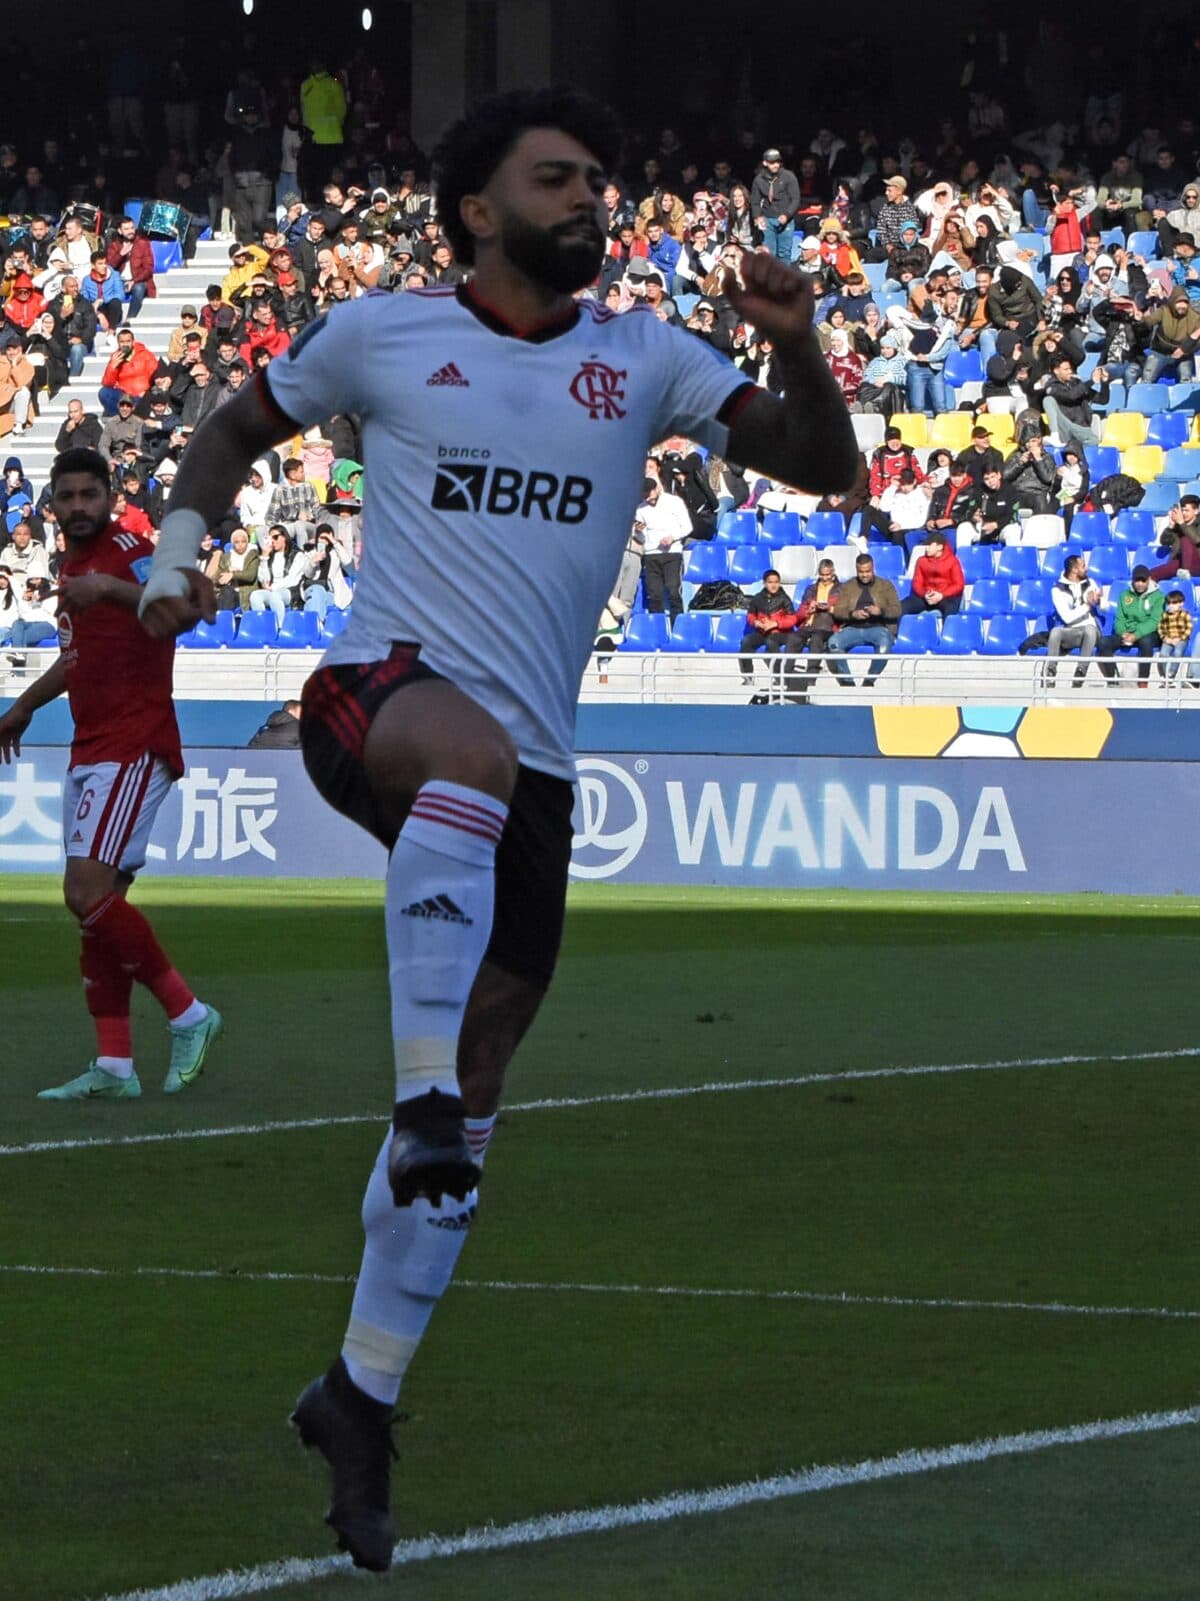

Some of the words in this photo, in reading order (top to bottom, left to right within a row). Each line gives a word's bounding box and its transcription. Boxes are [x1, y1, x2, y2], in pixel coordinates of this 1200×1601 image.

[437, 444, 492, 460] banco
[486, 467, 593, 525] BRB
[76, 788, 96, 820] 6
[665, 780, 1028, 872] WANDA
